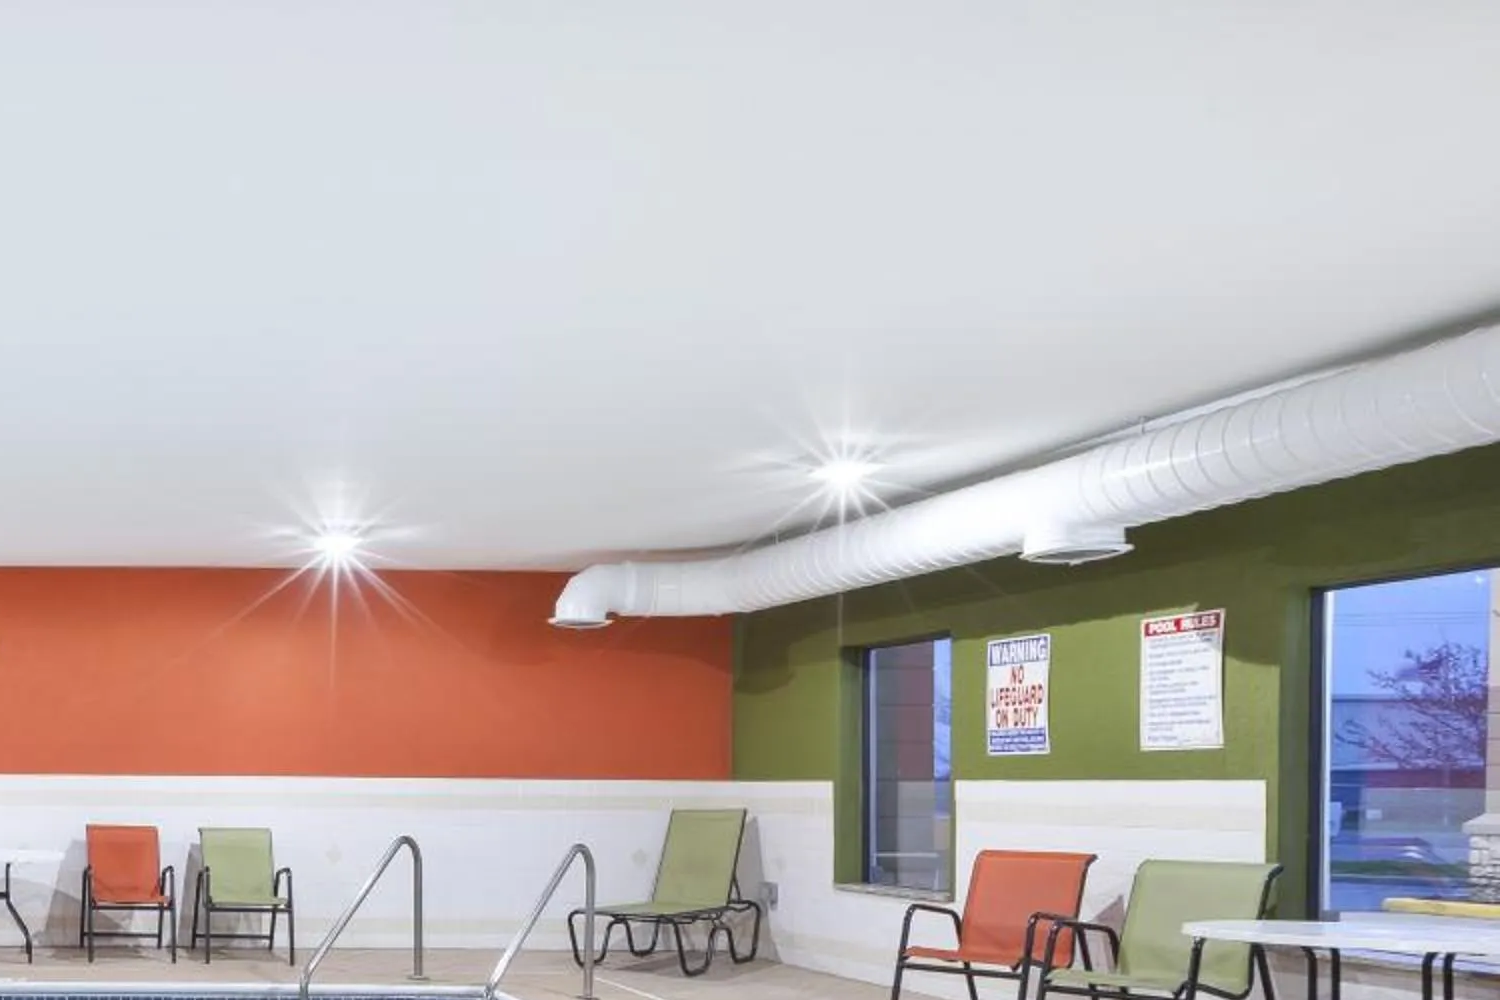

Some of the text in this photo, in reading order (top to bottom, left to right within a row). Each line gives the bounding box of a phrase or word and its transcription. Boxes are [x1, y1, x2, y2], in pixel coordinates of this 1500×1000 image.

[1148, 614, 1217, 635] POOL RULES
[990, 638, 1047, 664] WARNING
[1011, 665, 1025, 684] NO
[991, 684, 1044, 708] LIFEGUARD
[996, 706, 1039, 728] ON DUTY
